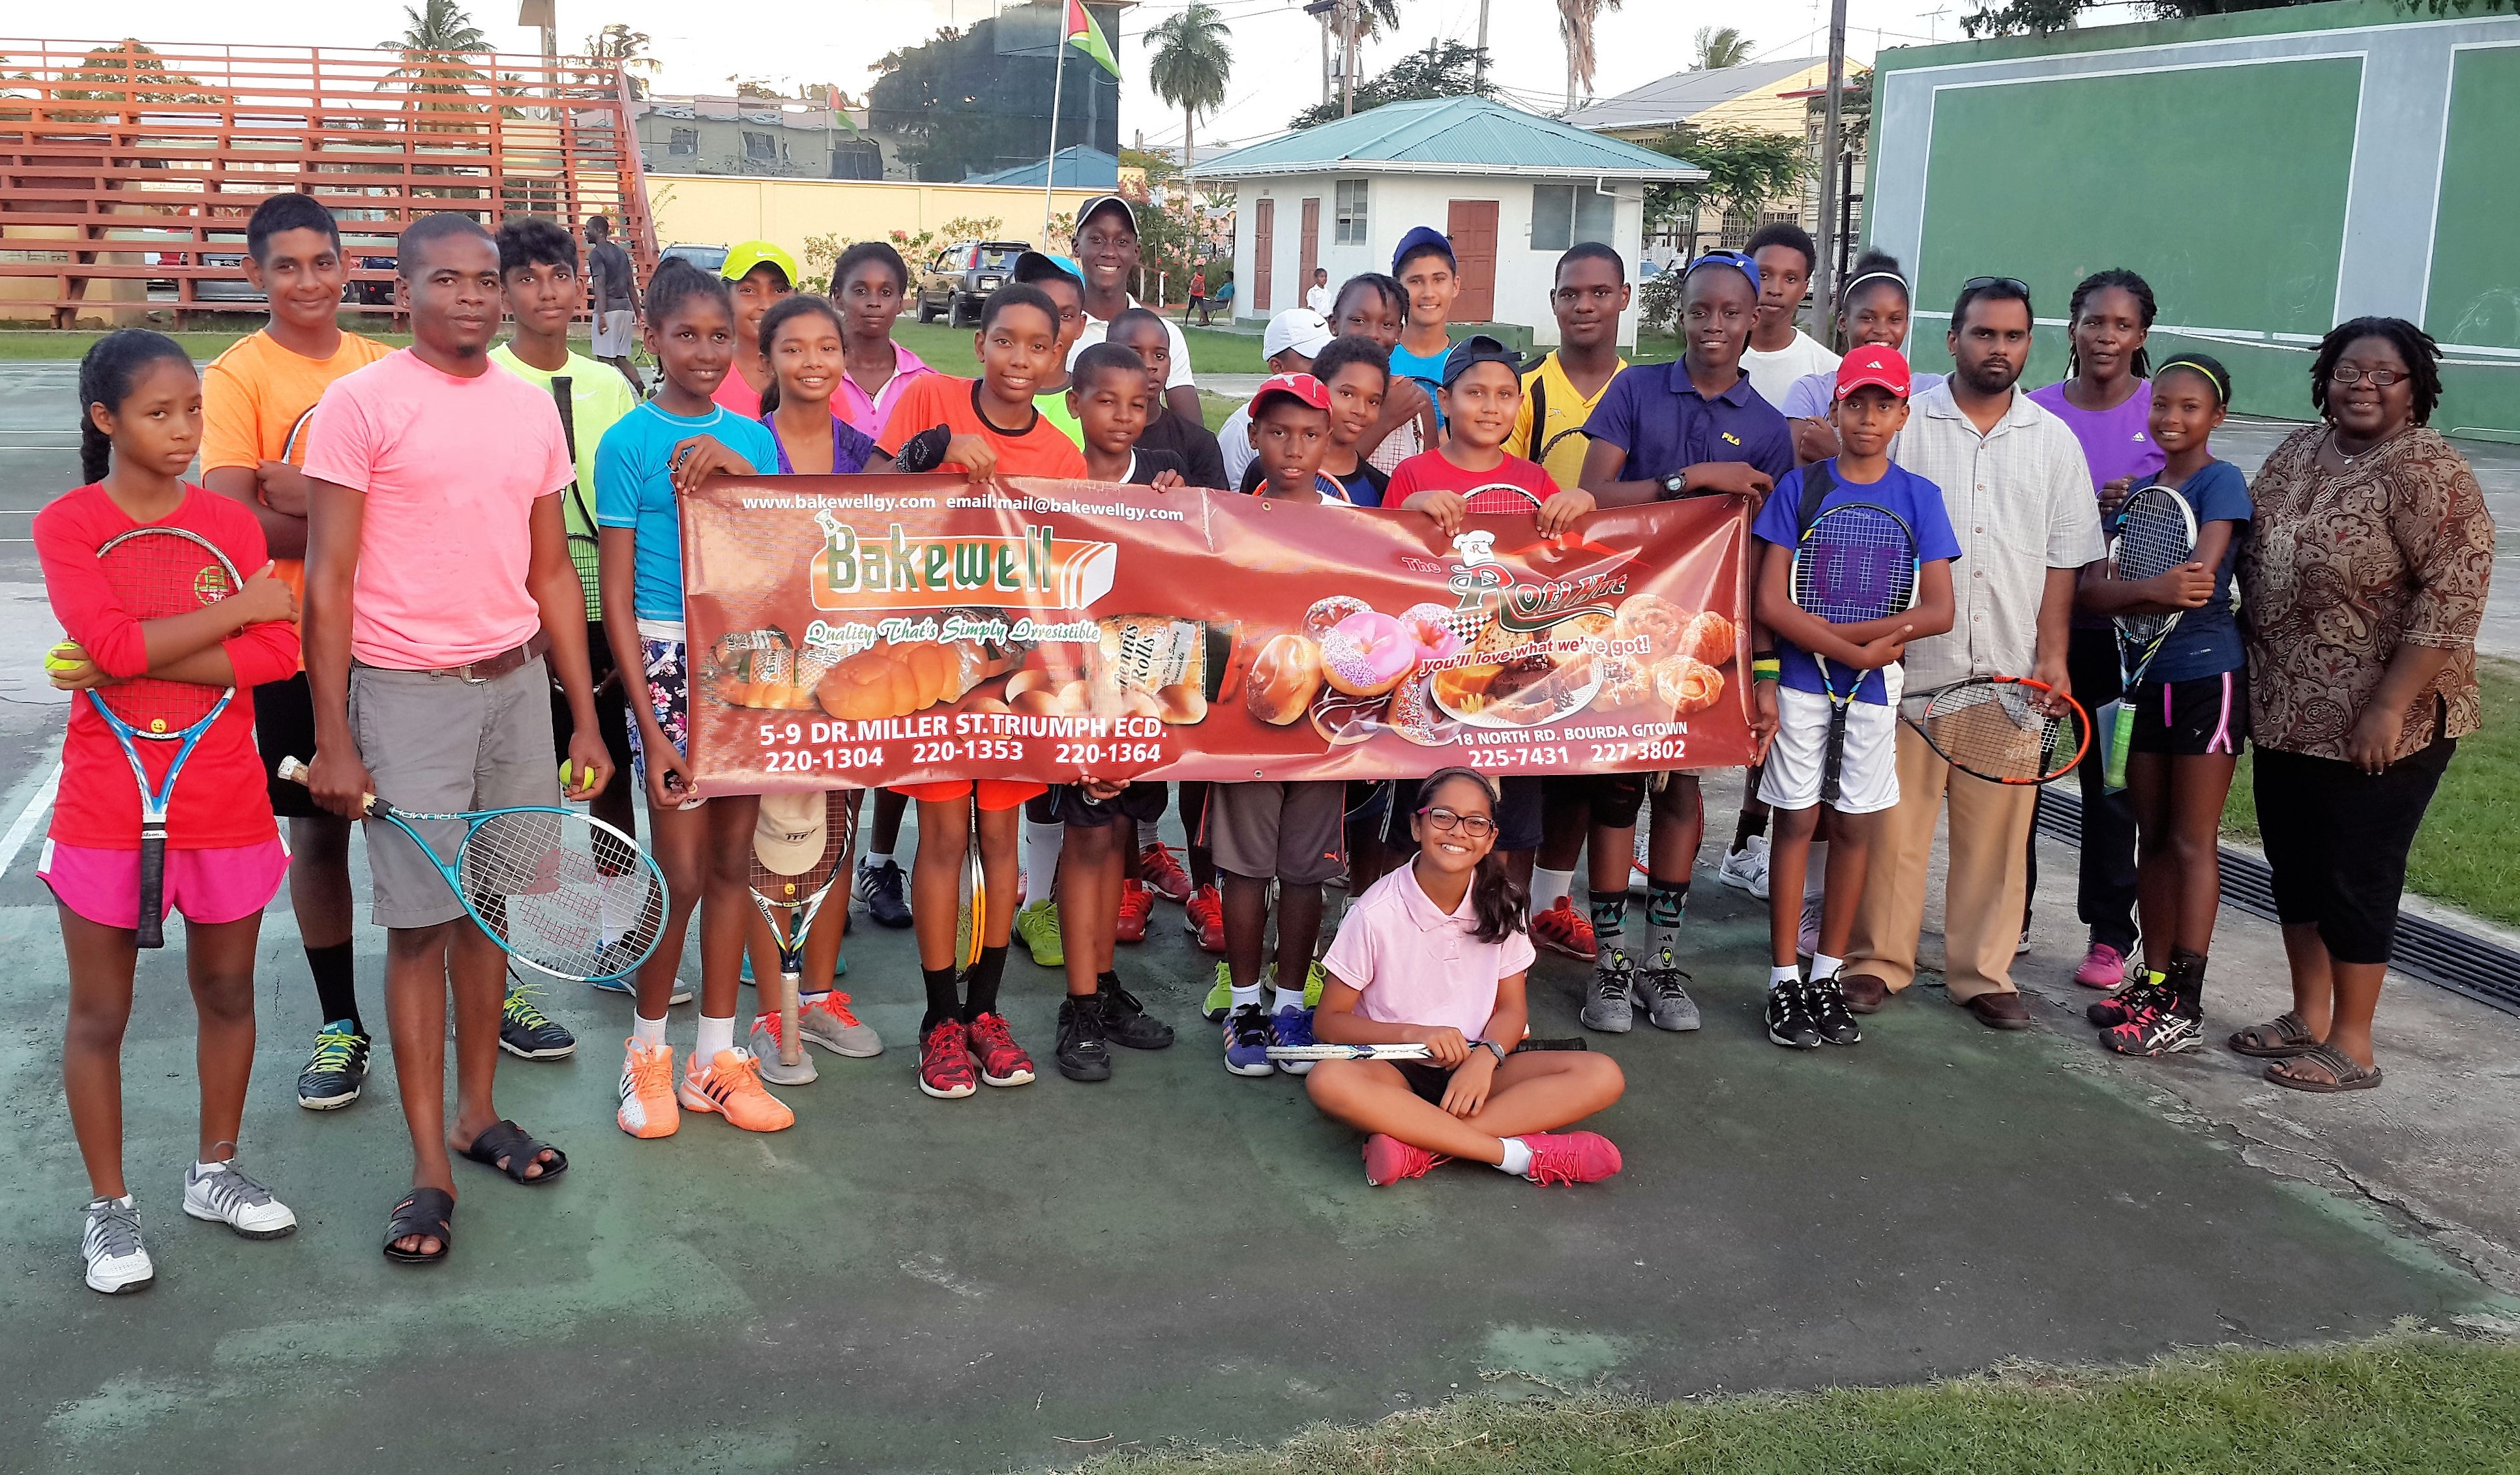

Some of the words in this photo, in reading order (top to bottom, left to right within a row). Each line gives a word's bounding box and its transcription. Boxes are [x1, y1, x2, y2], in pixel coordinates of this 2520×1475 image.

[1721, 431, 1741, 446] FILA
[742, 493, 936, 512] www.bakewellgy.com
[945, 493, 1184, 521] email:mail@bakewellgy.com
[827, 523, 1053, 592] Bakewell
[1402, 557, 1442, 574] The
[1448, 564, 1573, 630] Roti
[806, 621, 874, 647] Quality
[880, 619, 936, 642] That's
[940, 618, 1005, 643] Simply
[1114, 624, 1138, 686] Tennis
[1131, 635, 1155, 685] Rolls
[1423, 654, 1471, 675] you'll
[1475, 650, 1511, 664] love
[1515, 640, 1554, 658] what
[1557, 636, 1606, 652] we've
[1610, 635, 1651, 656] got!
[760, 723, 802, 746] 5-9
[810, 715, 949, 744] DR.MILLER
[955, 713, 1106, 738] ST.TRIUMPH
[1114, 717, 1168, 738] ECD.
[1456, 733, 1474, 746] 18
[1477, 729, 1531, 746] NORTH
[1534, 728, 1561, 743] RD.
[1565, 724, 1629, 741] BOURDA
[1631, 721, 1689, 738] G/TOWN
[765, 746, 884, 774] 220-1304
[912, 739, 1024, 764] 220-1353
[1054, 743, 1161, 764] 220-1364
[1468, 746, 1569, 768] 225-7431
[1590, 740, 1686, 763] 227-3802
[391, 807, 461, 820] TRIUMPH
[757, 897, 775, 925] Wilson
